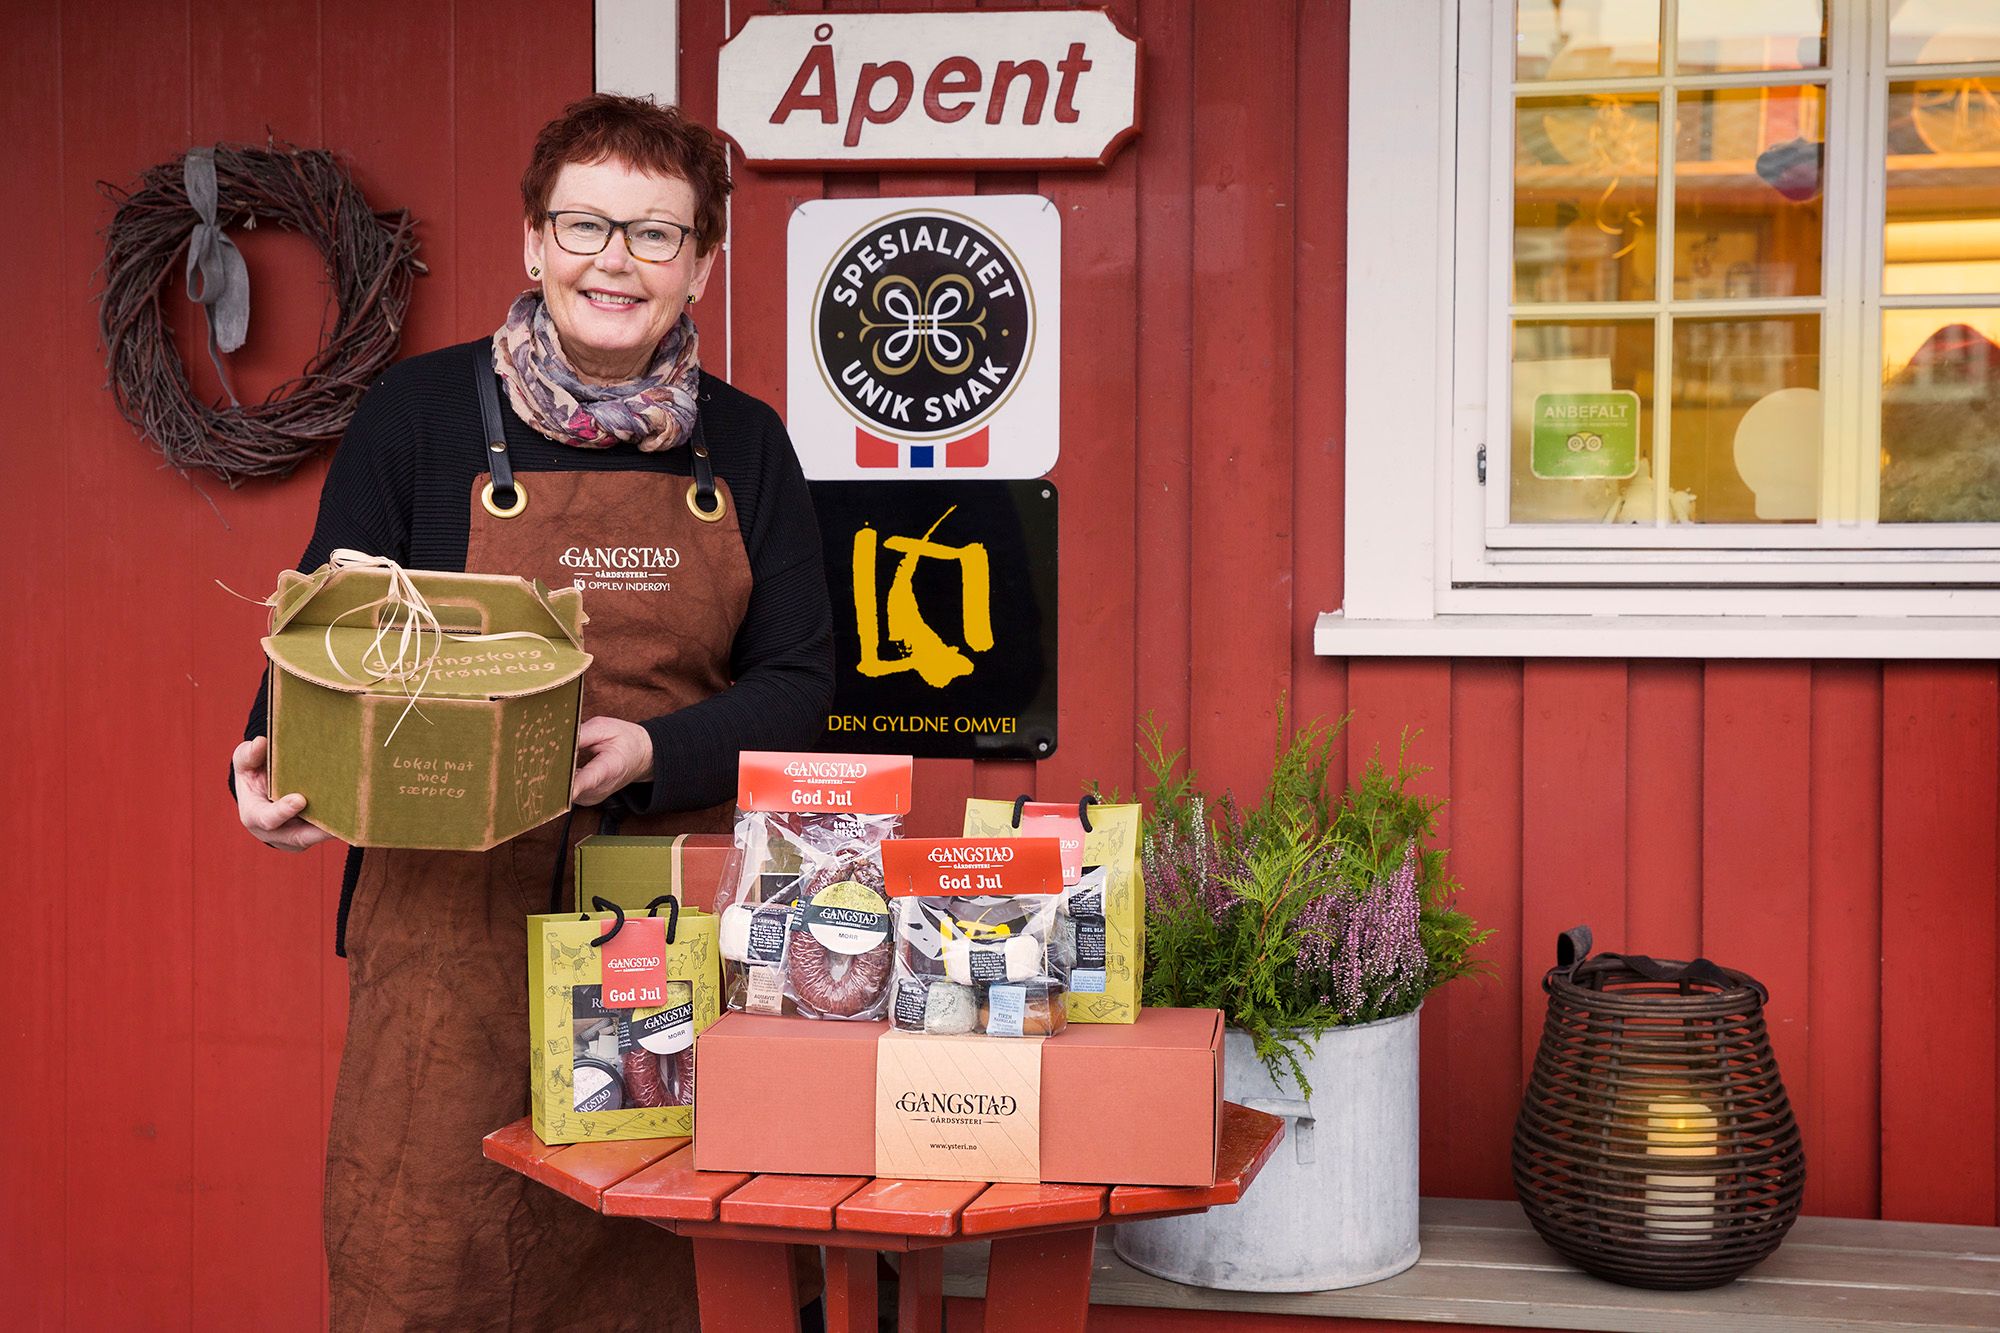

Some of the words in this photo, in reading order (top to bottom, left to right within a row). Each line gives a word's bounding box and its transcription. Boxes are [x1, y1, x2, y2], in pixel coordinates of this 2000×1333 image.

[769, 23, 1092, 147] Åpent
[832, 225, 1015, 307] SPESIALITET
[841, 359, 914, 422] UNIK
[924, 356, 1008, 422] SMAK
[1544, 405, 1628, 418] ANBEFALT
[559, 546, 680, 568] GANGSTAD
[595, 570, 648, 578] GÅRDSYSTERI
[588, 581, 623, 591] OPPLEV
[626, 582, 670, 591] INDERØY!
[828, 715, 866, 731] DEN
[872, 716, 949, 732] GYLDNE
[954, 717, 1016, 733] OMVEI
[393, 757, 437, 770] Lokal
[445, 761, 474, 771] mat
[784, 761, 867, 778] GANGSTAD
[417, 772, 449, 784] med
[399, 785, 466, 798] særpreg
[791, 789, 822, 805] God
[826, 790, 852, 806] Jul
[928, 846, 1014, 862] GANGSTAD
[1063, 867, 1075, 877] ul
[939, 875, 971, 889] God
[976, 874, 1003, 889] Jul
[820, 908, 878, 925] GANGSTAD
[608, 957, 660, 969] GANGSTAD
[610, 988, 635, 1001] God
[640, 987, 661, 1000] Jul
[895, 1092, 1017, 1116] GANGSTAD
[930, 1116, 982, 1125] GÅRDSYSTERI
[930, 1142, 977, 1150] www.ysteri.no
